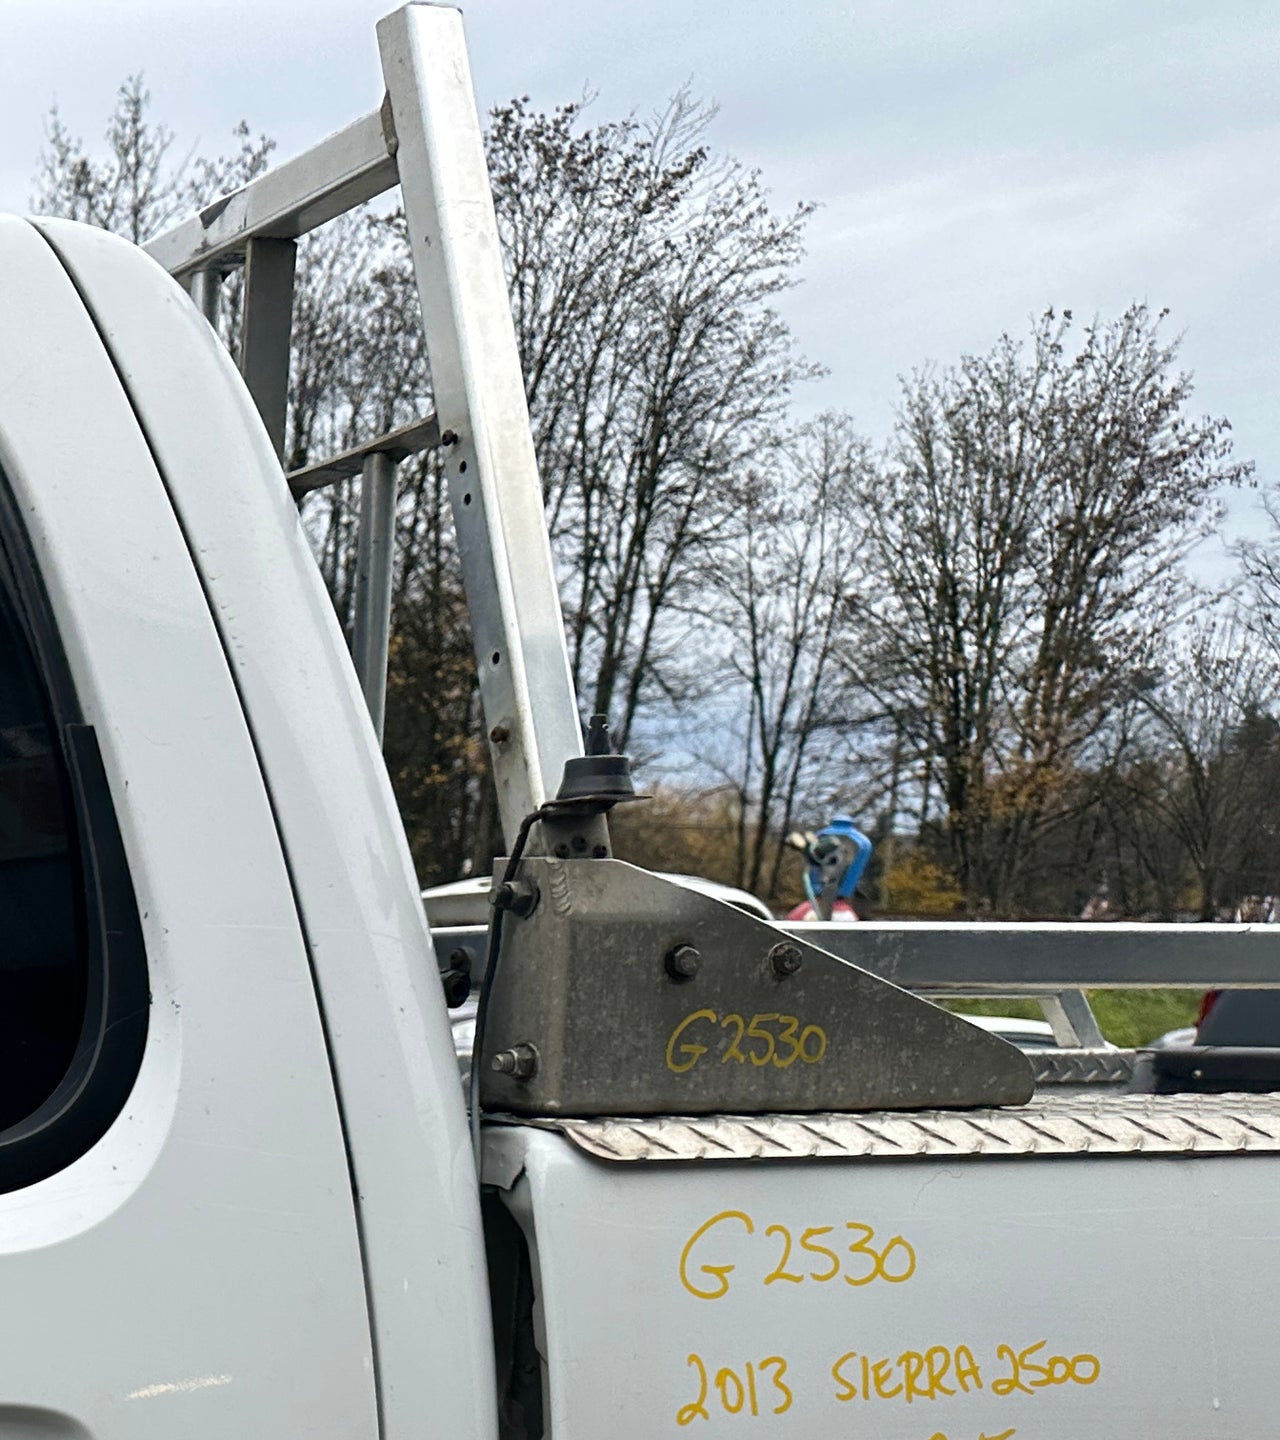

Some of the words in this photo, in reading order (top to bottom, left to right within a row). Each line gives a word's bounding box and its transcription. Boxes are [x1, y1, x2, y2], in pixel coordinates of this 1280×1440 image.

[665, 1008, 827, 1073] G2530
[679, 1210, 916, 1300] G2530
[676, 1353, 793, 1426] 2013
[831, 1345, 983, 1404] SIERRA
[991, 1340, 1101, 1396] 2500
